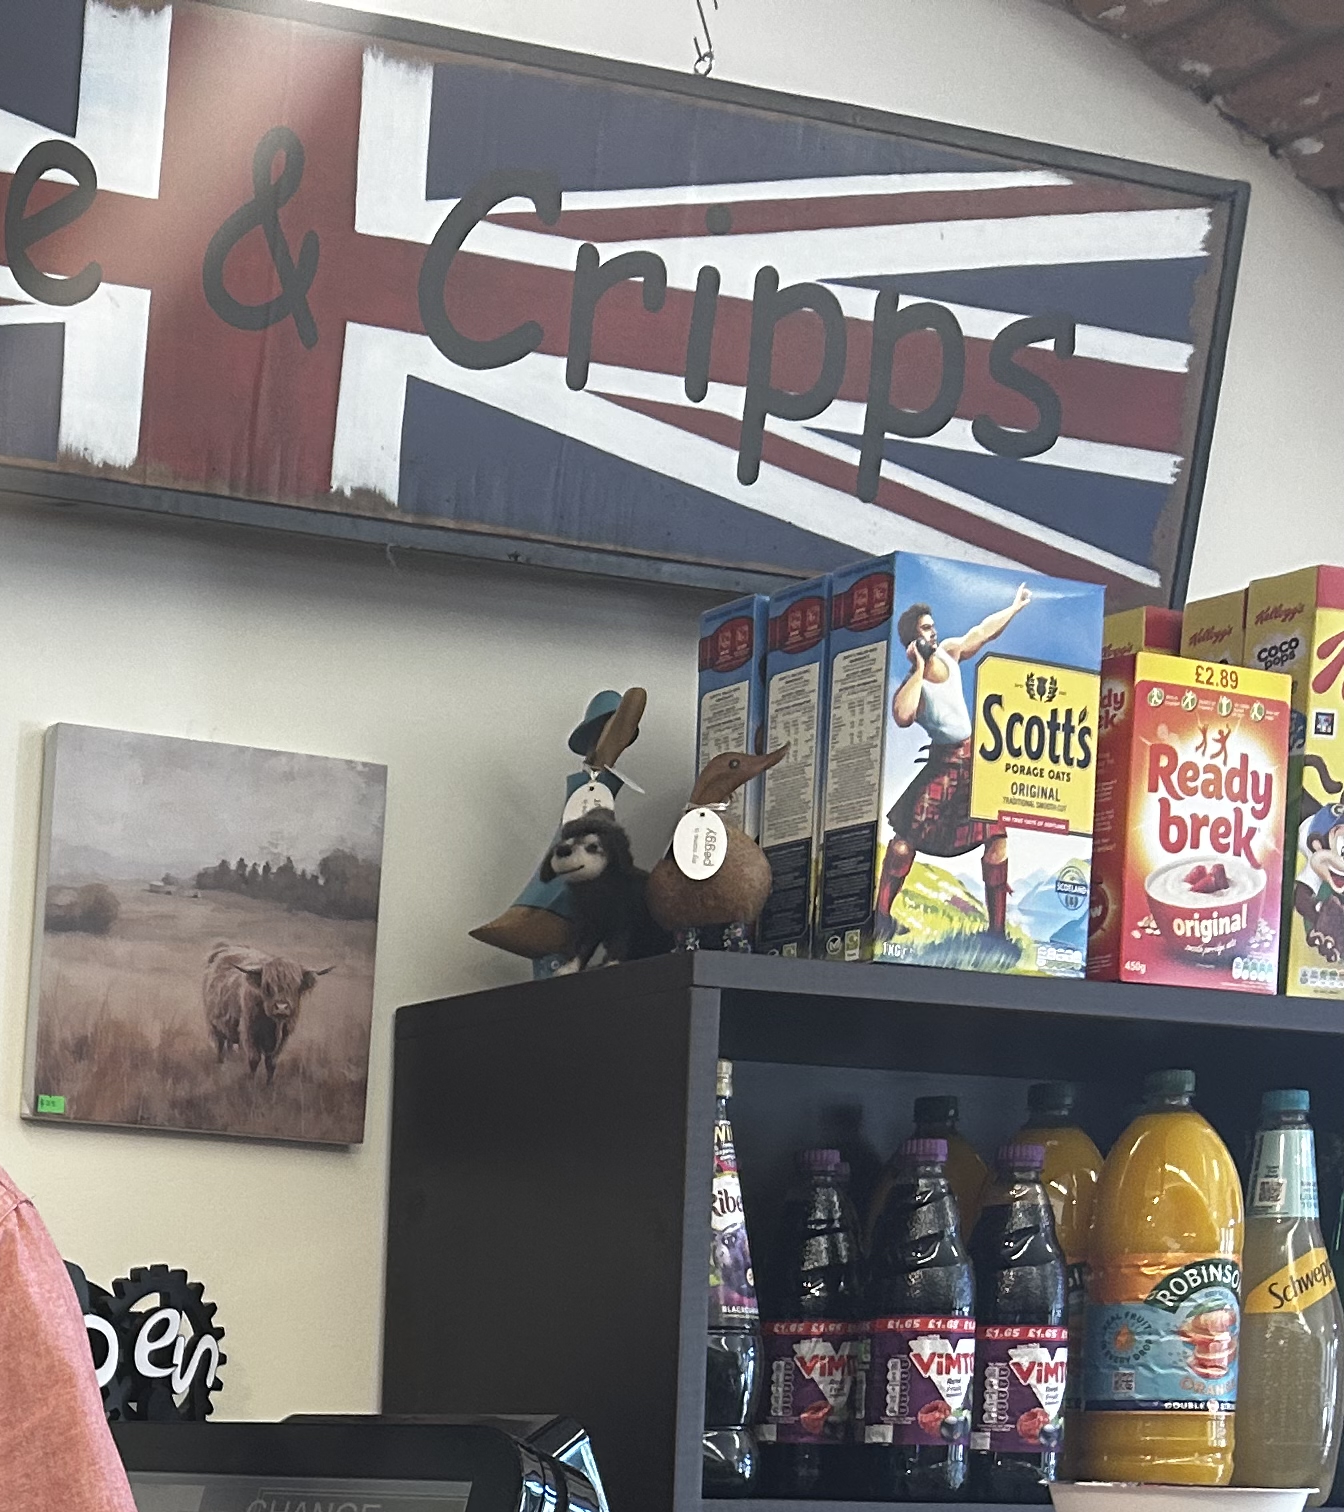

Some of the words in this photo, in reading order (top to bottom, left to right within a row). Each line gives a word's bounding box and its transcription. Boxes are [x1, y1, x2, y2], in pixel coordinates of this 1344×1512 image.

[202, 125, 320, 351] &
[417, 167, 1076, 504] Cripps
[1195, 664, 1239, 690] £2.89
[979, 693, 1092, 769] Scott's
[1004, 762, 1045, 780] PORAGE
[1048, 768, 1072, 783] OATS
[1010, 781, 1061, 802] ORIGINAL
[1148, 742, 1273, 820] Ready
[1158, 797, 1263, 869] brek
[1172, 904, 1248, 943] original
[1156, 1263, 1242, 1308] ROBINSO
[1267, 1258, 1333, 1310] Schwepp
